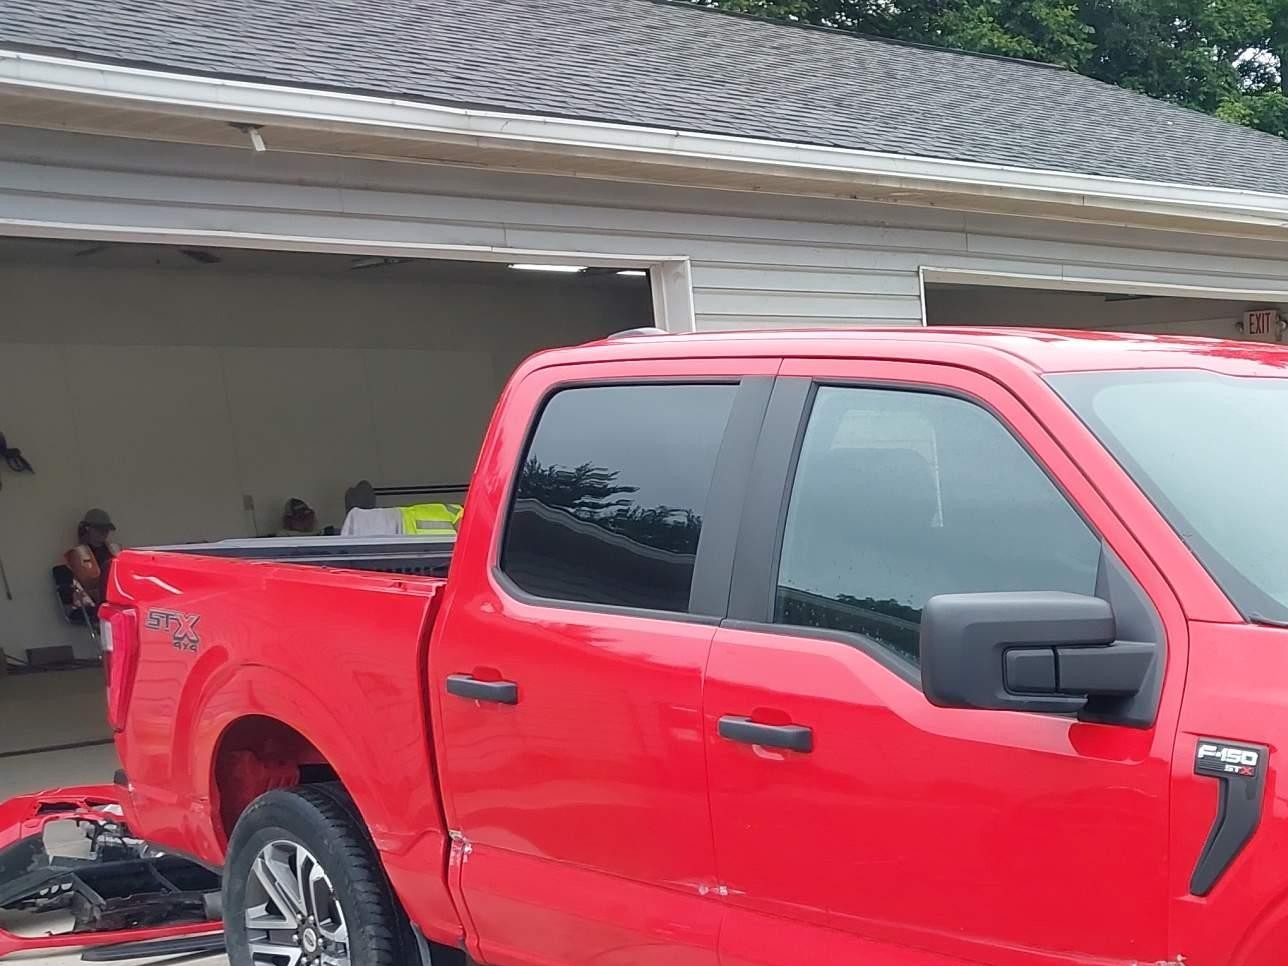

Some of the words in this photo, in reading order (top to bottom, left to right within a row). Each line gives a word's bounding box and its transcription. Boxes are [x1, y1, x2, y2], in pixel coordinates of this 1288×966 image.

[1248, 312, 1271, 335] EXIT
[145, 607, 200, 643] STX
[1197, 744, 1259, 766] F-150
[1224, 764, 1254, 776] STX
